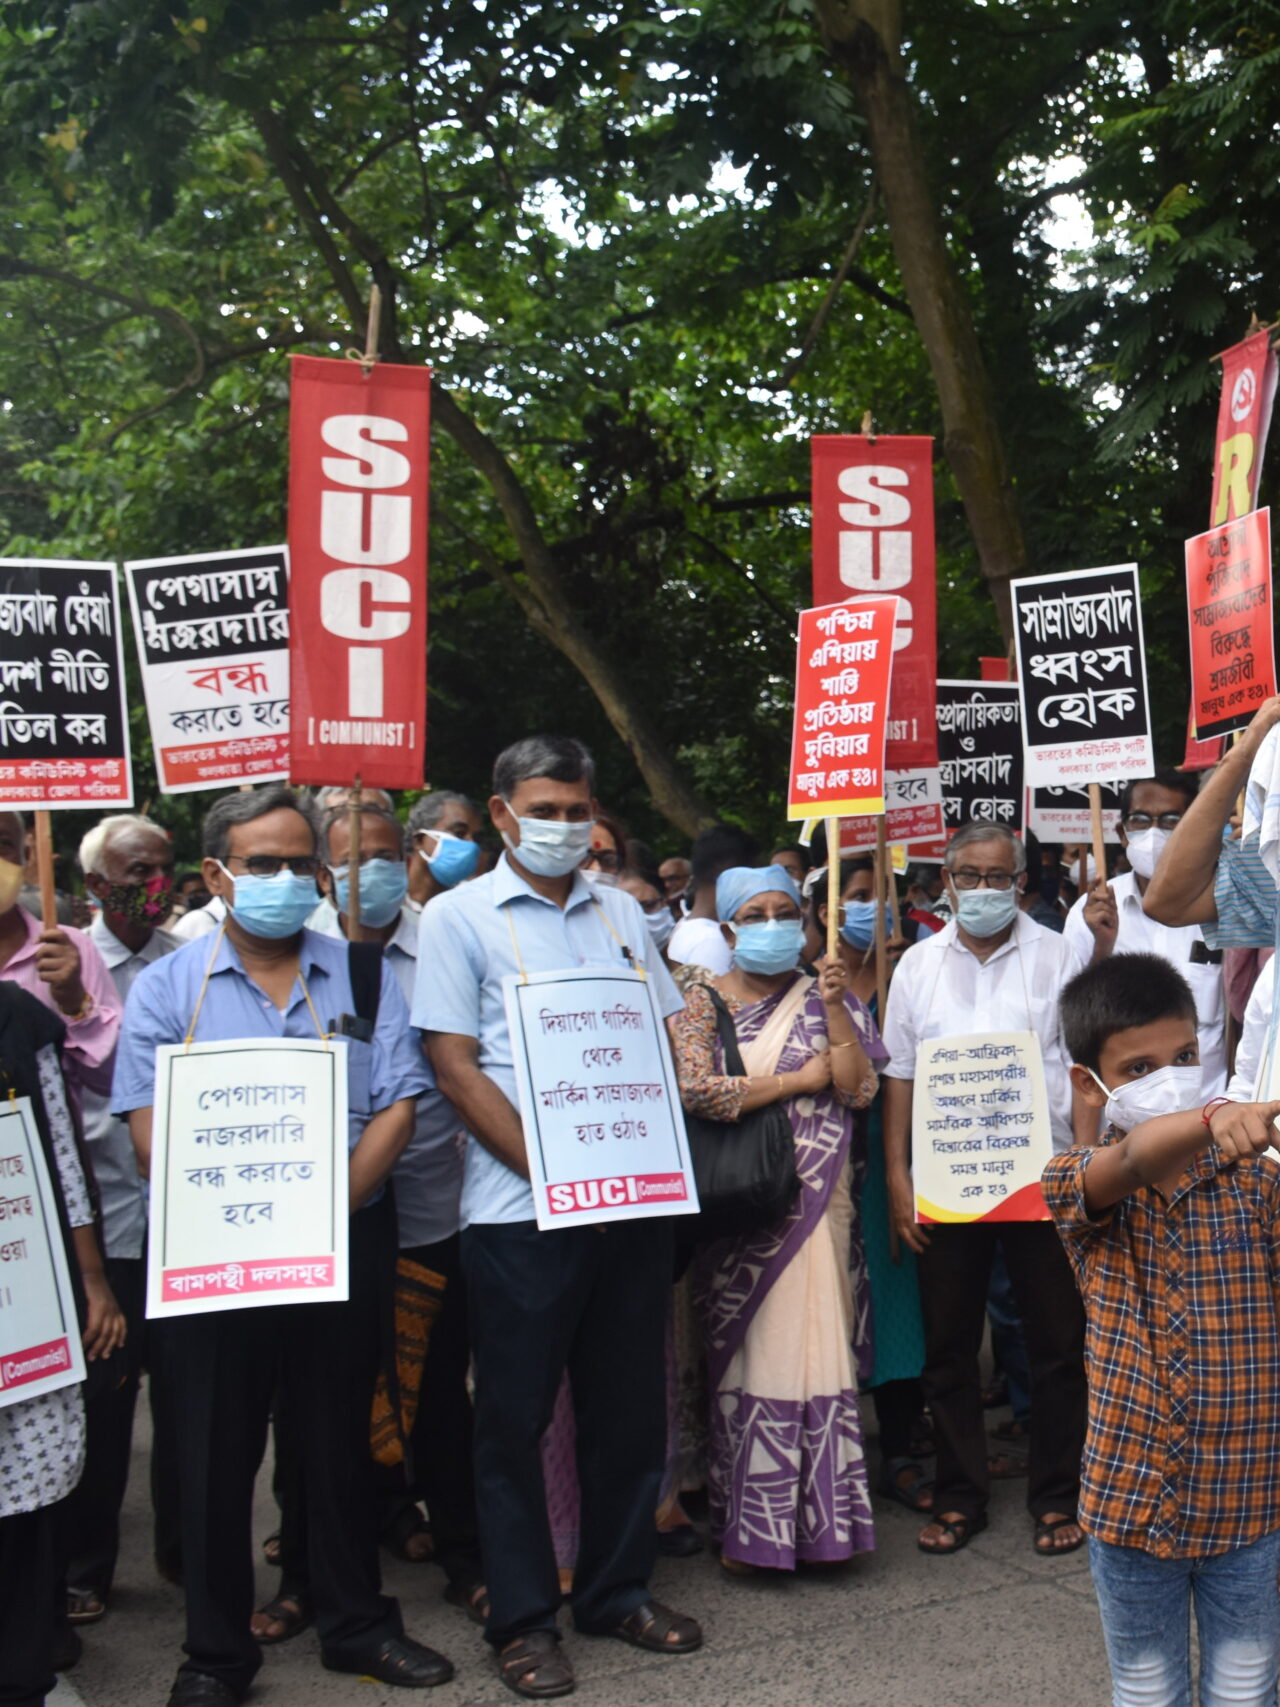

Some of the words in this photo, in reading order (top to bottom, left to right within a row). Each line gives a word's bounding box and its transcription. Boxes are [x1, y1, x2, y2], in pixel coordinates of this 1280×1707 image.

[321, 414, 412, 718] SUCI
[146, 566, 280, 611] পেগাসাস
[0, 588, 58, 637] জ্যবাদ
[816, 609, 876, 637] পশ্চিম
[1019, 586, 1134, 642] সাম্রাজ্যবাদ
[809, 639, 879, 669] এশিয়ায়
[1210, 625, 1252, 658] বিরুদ্ধে
[49, 648, 111, 693] নীতি
[187, 662, 269, 696] বন্ধ
[1029, 645, 1134, 686] ধ্বংস
[1209, 653, 1254, 692] শ্রমজীবী
[820, 668, 860, 697] শান্তি
[803, 699, 876, 732] প্রতিষ্ঠায়
[1037, 687, 1137, 729] হোক
[1201, 695, 1225, 717] মানুষ
[1227, 690, 1245, 706] এক
[0, 701, 58, 748] তিল
[62, 713, 108, 746] কর
[169, 705, 244, 736] করতে
[804, 731, 870, 768] দুনিয়ার
[959, 736, 975, 752] ও
[796, 771, 826, 798] মানুষ
[827, 769, 850, 789] এক
[894, 777, 929, 801] হবে
[969, 796, 1017, 822] হোক
[538, 1007, 598, 1036] দিয়াগো
[582, 1046, 623, 1069] থেকে
[959, 1064, 1027, 1084] মহাসাগরীয়
[198, 1085, 307, 1111] পেগাসাস
[540, 1080, 589, 1110] মার্কিন
[593, 1082, 664, 1105] সাম্রাজ্যবাদ
[980, 1088, 1022, 1106] মার্কিন
[193, 1114, 306, 1148] নজরদারি
[574, 1122, 606, 1147] হাত
[611, 1113, 648, 1141] ওঠাও
[926, 1116, 973, 1132] সামরিক
[184, 1166, 226, 1189] বন্ধ
[234, 1161, 316, 1184] করতে
[982, 1159, 1015, 1177] মানুষ
[960, 1185, 984, 1198] এক
[987, 1183, 1008, 1196] হও
[221, 1201, 275, 1229] হবে
[168, 1264, 246, 1293] বামপন্থী
[250, 1262, 330, 1286] দলসমূহ
